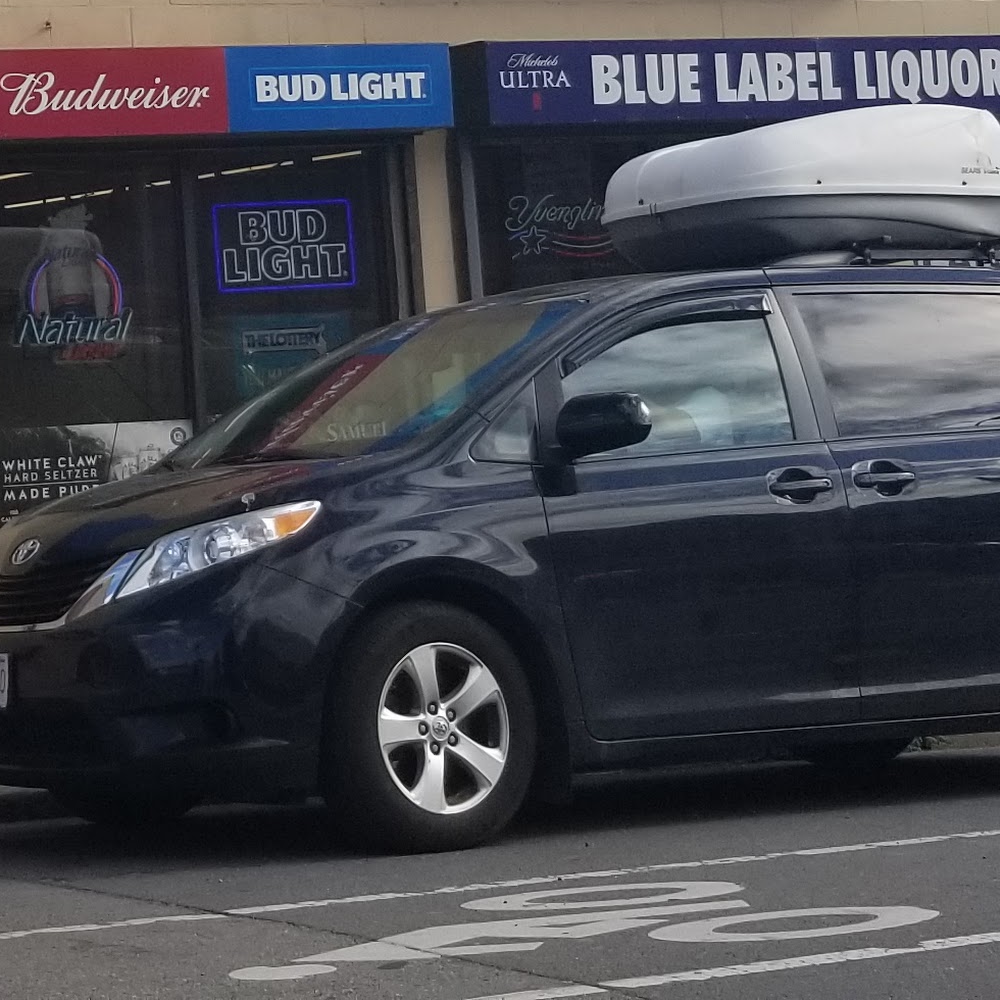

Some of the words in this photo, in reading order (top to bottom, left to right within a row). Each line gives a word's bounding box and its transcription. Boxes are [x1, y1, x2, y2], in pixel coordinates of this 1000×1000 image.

[0, 71, 210, 116] Budweiser
[255, 74, 326, 103] BUD
[331, 71, 426, 100] LIGHT
[499, 70, 571, 88] ULTRA
[591, 53, 701, 105] BLUE
[714, 51, 842, 102] LABEL
[853, 48, 1000, 104] LIQUOR
[238, 209, 327, 245] BUD
[223, 243, 346, 283] LIGHT
[19, 307, 133, 345] Natural
[2, 458, 51, 471] WHITE
[58, 455, 98, 468] CLAW
[4, 472, 39, 483] HARD
[45, 468, 97, 480] SELTZER
[4, 487, 50, 501] MADE
